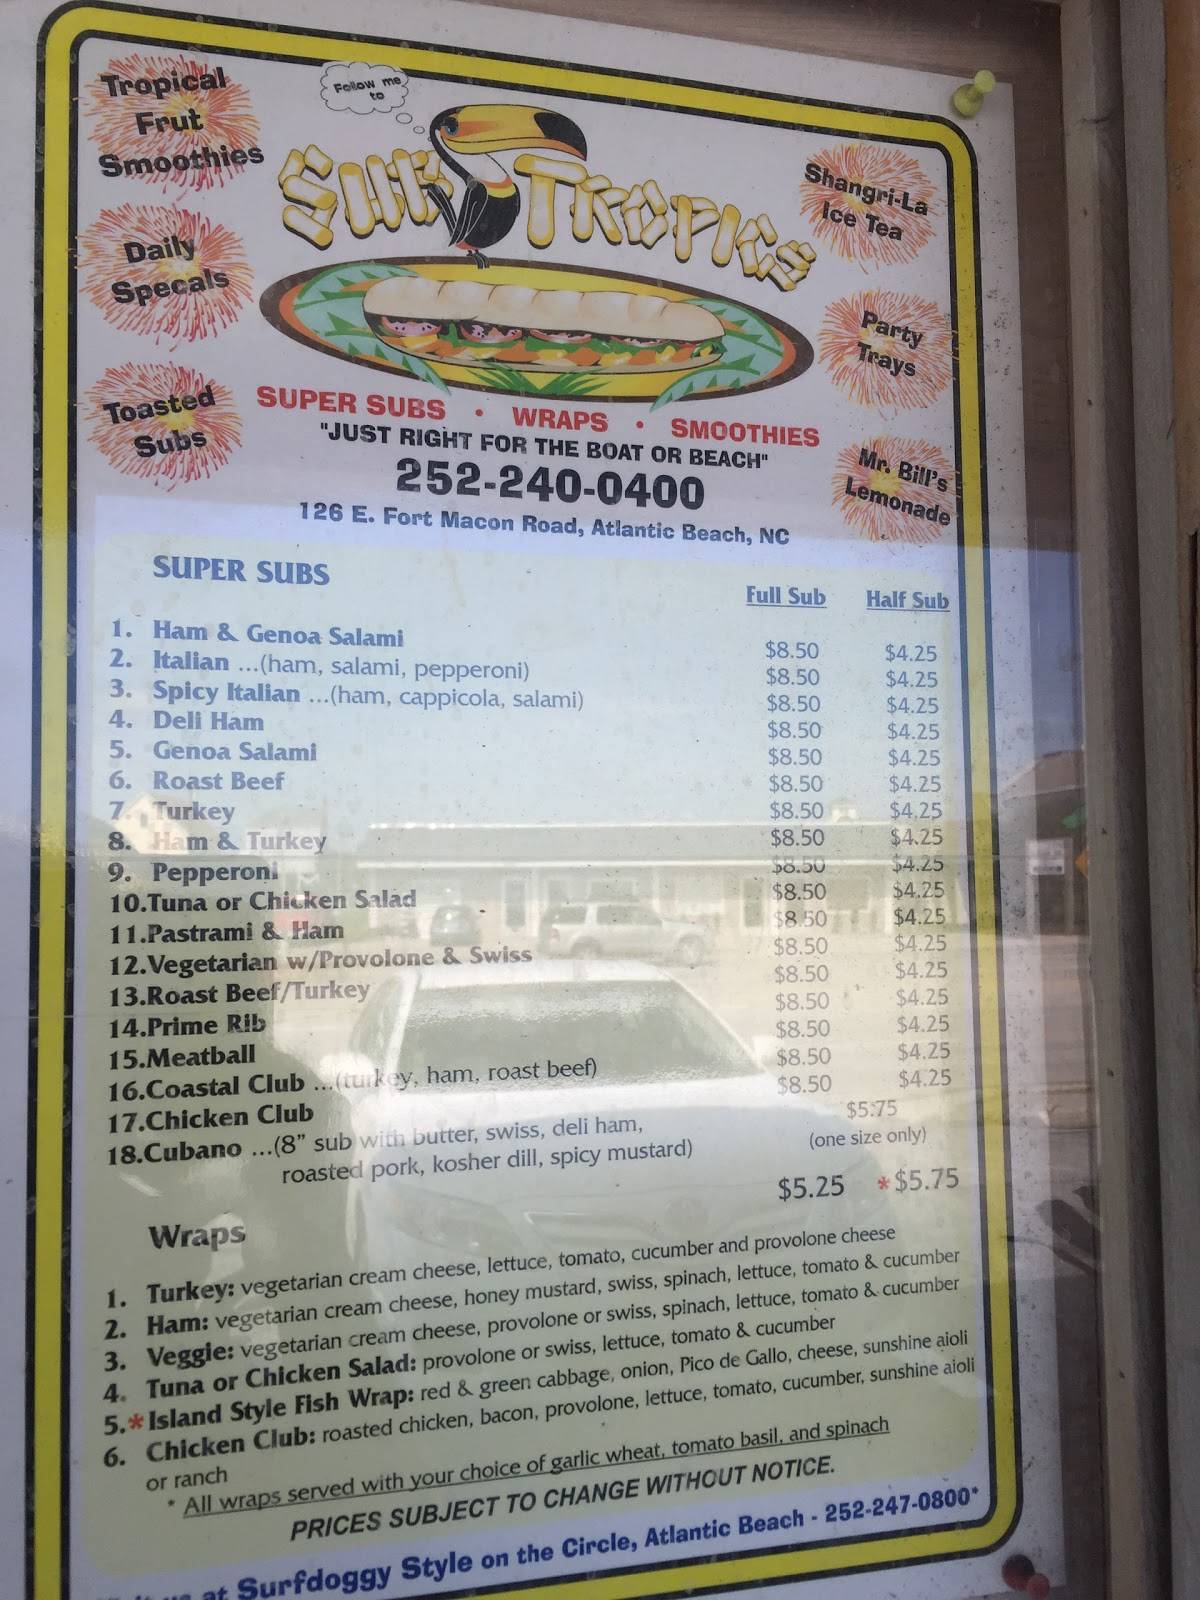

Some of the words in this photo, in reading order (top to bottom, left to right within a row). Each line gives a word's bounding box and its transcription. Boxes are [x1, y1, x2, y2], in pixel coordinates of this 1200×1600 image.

[100, 67, 227, 99] Tropical
[333, 80, 376, 93] Follow
[382, 76, 402, 87] me
[369, 92, 385, 101] to
[135, 110, 204, 135] Frut
[98, 145, 265, 177] Smoothies
[805, 163, 929, 216] Shangri-La
[514, 153, 816, 291] TROPICS
[821, 202, 856, 228] Ice
[865, 213, 903, 241] Tea
[124, 235, 195, 265] Daily
[112, 269, 230, 306] Specals
[861, 310, 923, 349] Party
[857, 344, 916, 378] Trays
[102, 386, 215, 424] Toasted
[257, 386, 357, 415] SUPER
[366, 395, 445, 421] SUBS
[512, 406, 609, 433] WRAPS
[671, 418, 820, 447] SMOOTHIES
[134, 431, 208, 457] Subs
[320, 422, 391, 444] "JUST
[400, 428, 472, 450] RIGHT
[481, 434, 527, 454] FOR
[535, 438, 579, 457] THE
[587, 441, 643, 461] BOAT
[651, 446, 682, 464] OR
[690, 449, 768, 468] BEACH"
[396, 457, 705, 511] 252-240-0400
[858, 447, 891, 473] Mr.
[898, 460, 948, 493] Bill's
[845, 476, 951, 528] Lemonade
[300, 502, 343, 521] 126
[352, 505, 375, 523] E.
[383, 507, 432, 527] Fort
[441, 511, 513, 531] Macon
[522, 515, 584, 536] Road,
[591, 518, 674, 539] Atlantic
[683, 523, 752, 545] Beach,
[759, 528, 789, 545] NC
[153, 555, 247, 582] SUPER
[256, 561, 331, 586] SUBS
[746, 586, 781, 605] Full
[788, 587, 826, 607] Sub
[866, 590, 906, 609] Half
[912, 591, 949, 611] Sub
[111, 619, 132, 638] 1.
[153, 619, 208, 641] Ham
[217, 623, 239, 643] &
[247, 624, 321, 645] Genoa
[329, 627, 404, 648] Salami
[766, 641, 819, 660] $8.50
[886, 645, 938, 662] $4.25
[110, 649, 132, 669] 2.
[153, 650, 229, 671] Italian
[331, 657, 406, 679] salami,
[415, 660, 530, 682] pepperoni)
[766, 667, 820, 687] $8.50
[886, 671, 938, 689] $4.25
[110, 679, 132, 699] 3.
[153, 680, 218, 705] Spicy
[227, 681, 300, 703] Italian
[400, 688, 506, 711] cappicola,
[513, 690, 584, 712] salami)
[767, 694, 821, 714] $8.50
[887, 698, 939, 714] $4.25
[110, 740, 132, 760] 5.
[153, 742, 231, 761] Genoa
[240, 742, 317, 762] Salami
[769, 748, 822, 767] $8.50
[888, 749, 941, 766] $4.25
[218, 895, 240, 912] or
[249, 890, 347, 911] Chicken
[355, 890, 417, 909] Salad
[772, 883, 826, 901] $8.50
[893, 881, 945, 899] $4.25
[261, 922, 284, 941] &
[292, 923, 344, 940] Ham
[287, 948, 435, 971] w/Provolone
[443, 947, 462, 966] &
[470, 946, 532, 965] Swiss
[896, 961, 948, 979] $4.25
[775, 965, 829, 984] $8.50
[226, 981, 370, 1005] Beef/Turkey
[778, 1075, 832, 1095] $8.50
[899, 1069, 951, 1089] $4.25
[847, 1099, 897, 1119] $5.75
[314, 1133, 352, 1154] sub
[360, 1131, 405, 1149] with
[413, 1124, 478, 1147] butter,
[486, 1121, 545, 1141] swiss,
[552, 1117, 588, 1136] deli
[595, 1114, 643, 1136] ham,
[809, 1132, 846, 1151] (one
[851, 1129, 882, 1145] size
[887, 1126, 926, 1144] only)
[282, 1160, 363, 1184] roasted
[371, 1157, 425, 1183] pork,
[433, 1153, 500, 1174] kosher
[506, 1149, 544, 1169] dill,
[550, 1147, 601, 1168] spicy
[607, 1140, 693, 1163] mustard)
[778, 1174, 844, 1202] $5.25
[149, 1223, 246, 1251] Wraps
[107, 1290, 126, 1309] 1.
[147, 1282, 234, 1305] Turkey:
[241, 1274, 343, 1299] vegetarian
[349, 1267, 406, 1286] cream
[413, 1262, 481, 1281] cheese,
[488, 1254, 552, 1273] lettuce,
[559, 1249, 625, 1268] tomato,
[631, 1238, 713, 1262] cucumber
[719, 1236, 748, 1254] and
[754, 1230, 837, 1254] provolone
[841, 1225, 896, 1244] cheese
[104, 1447, 126, 1468] 6.
[146, 1437, 245, 1463] Chicken
[254, 1429, 315, 1450] Club:
[322, 1420, 393, 1443] roasted
[399, 1412, 473, 1435] chicken,
[481, 1405, 539, 1425] bacon,
[546, 1393, 639, 1422] provolone,
[645, 1384, 706, 1407] lettuce,
[713, 1377, 777, 1400] tomato,
[782, 1369, 865, 1393] cucumber,
[870, 1360, 938, 1383] sunshine
[943, 1357, 975, 1374] aioli
[290, 1511, 382, 1541] PRICES
[389, 1496, 500, 1529] SUBJECT
[507, 1493, 536, 1514] TO
[544, 1478, 640, 1508] CHANGE
[646, 1465, 747, 1496] WITHOUT
[752, 1456, 835, 1483] NOTICE.
[238, 1566, 391, 1600] Surfdoggy
[402, 1551, 472, 1580] Style
[481, 1551, 509, 1569] on
[517, 1539, 554, 1562] the
[562, 1532, 638, 1558] Circle,
[644, 1513, 731, 1547] Atlantic
[738, 1508, 804, 1535] Beach
